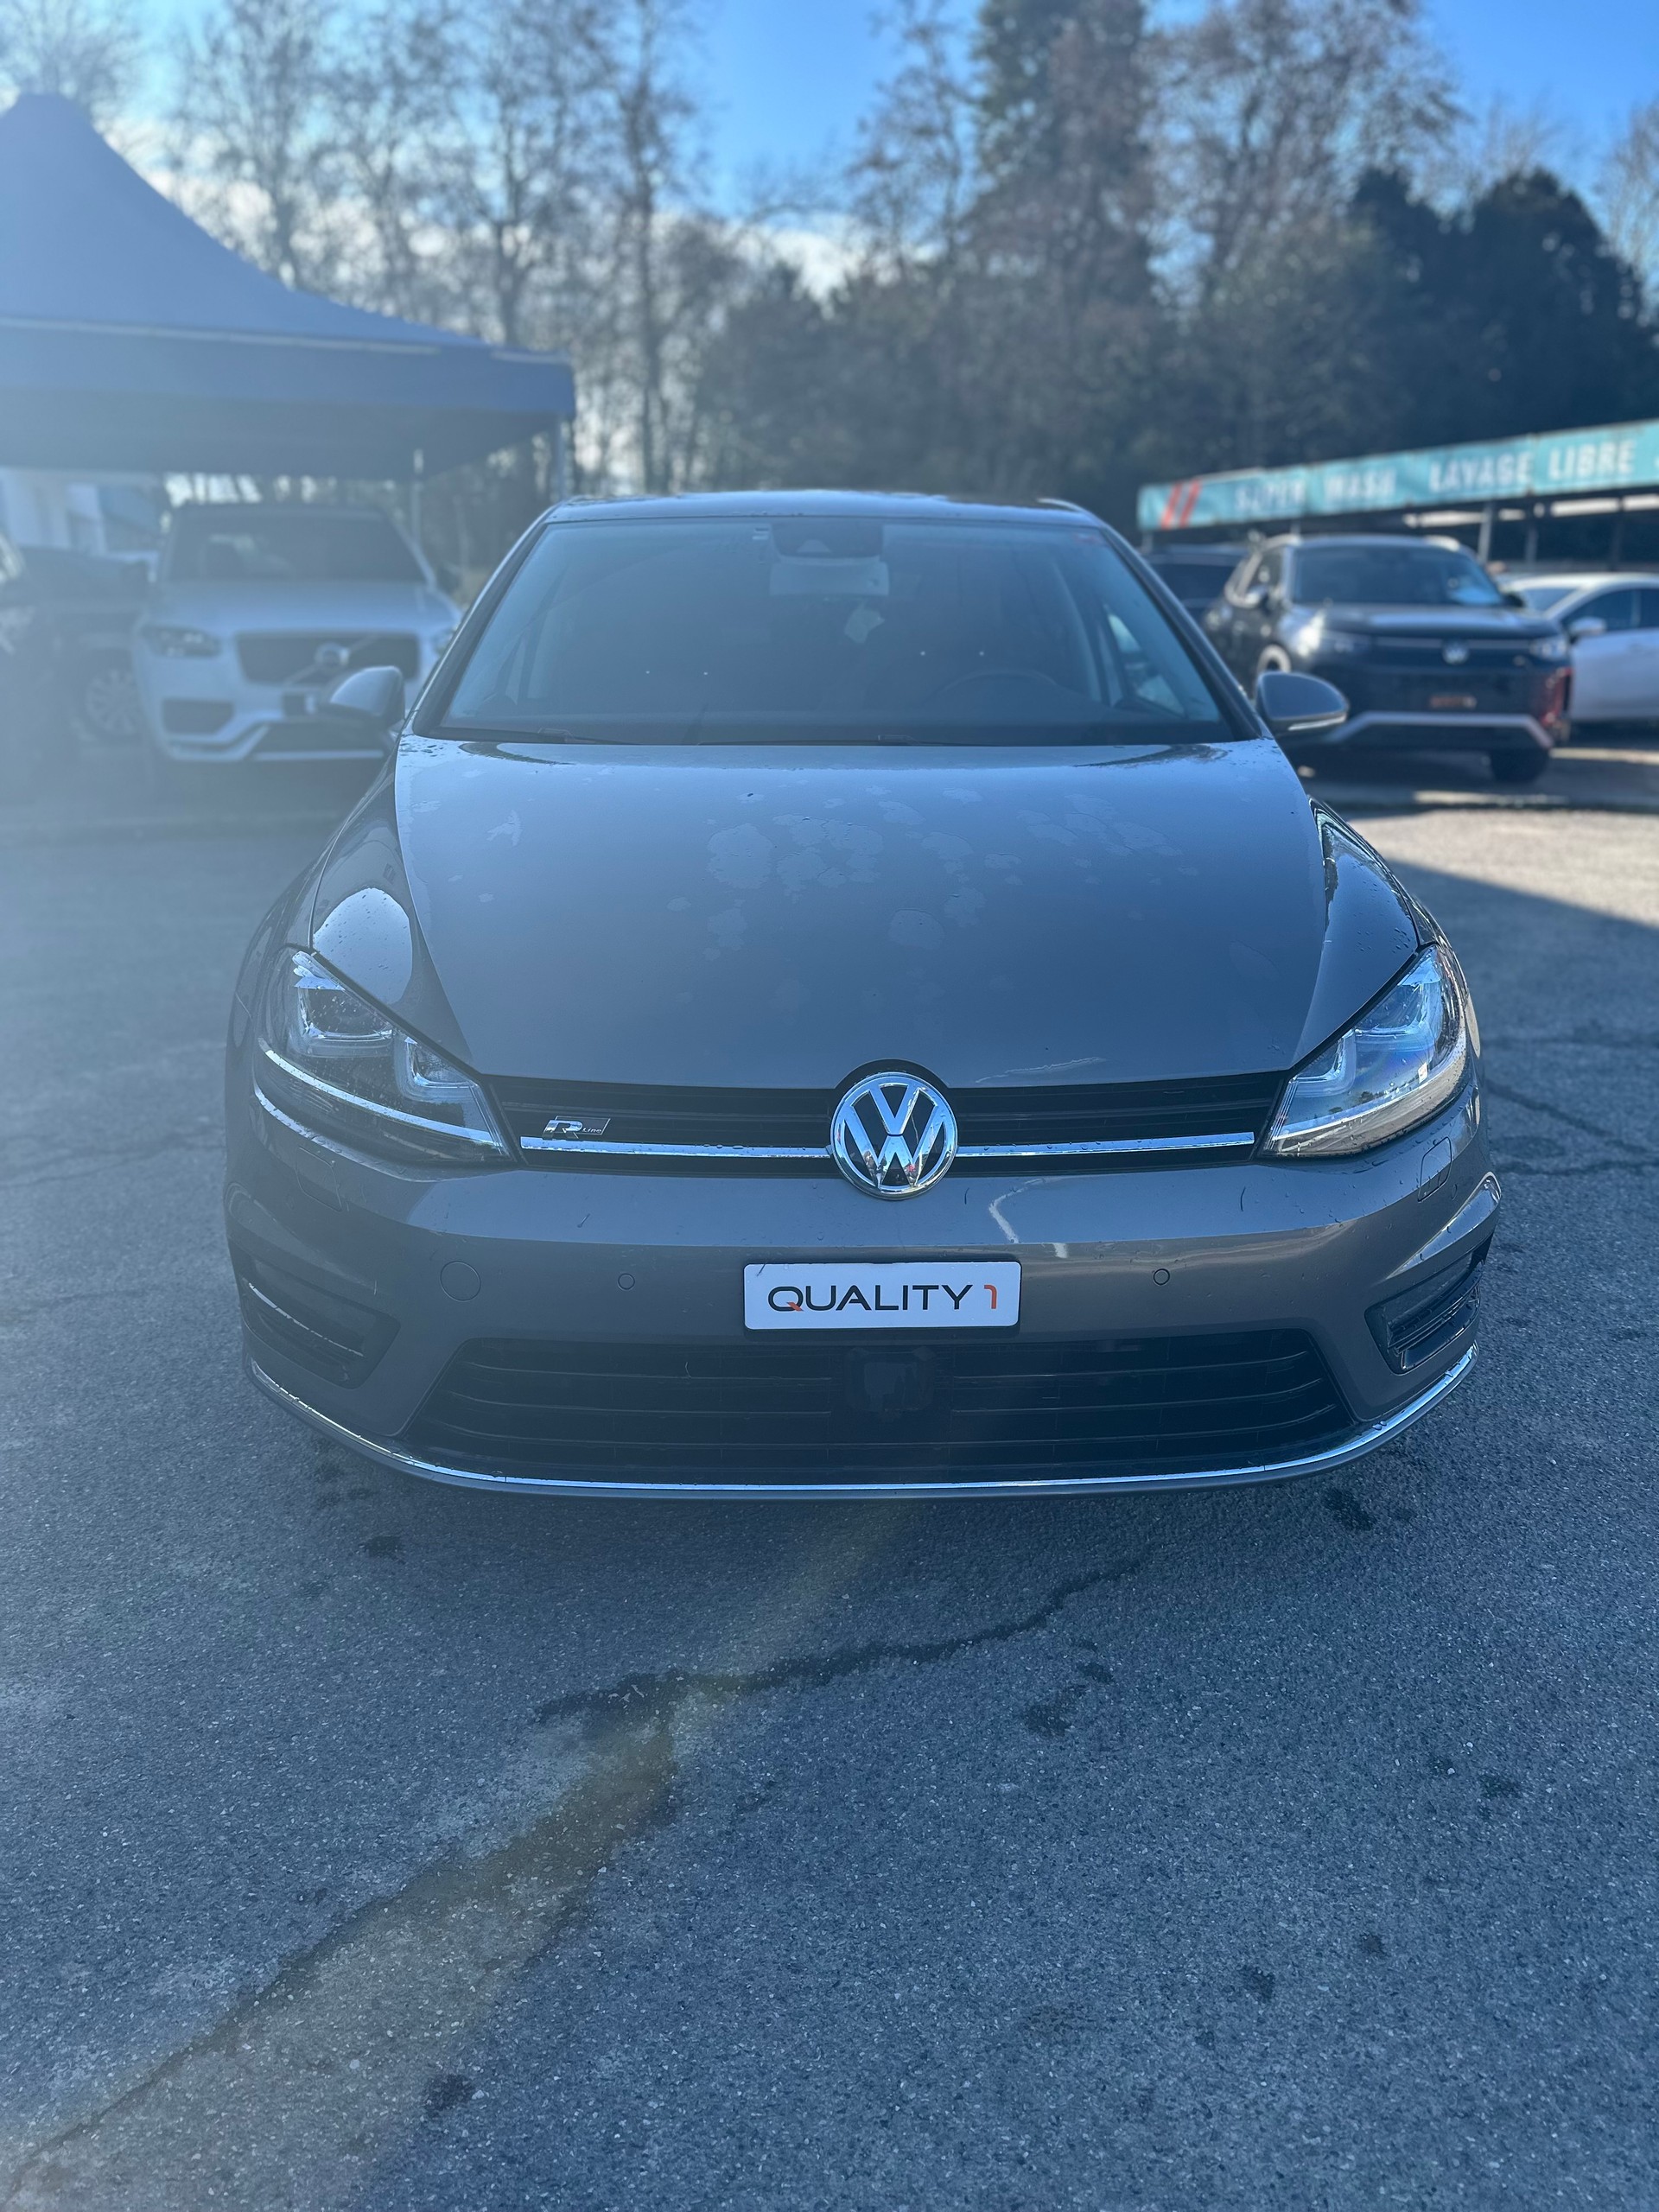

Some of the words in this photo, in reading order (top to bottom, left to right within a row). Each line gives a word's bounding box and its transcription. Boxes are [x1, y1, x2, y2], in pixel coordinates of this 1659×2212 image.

[1429, 450, 1534, 493] LAVAGE
[1548, 439, 1637, 481] LIBRE
[767, 1284, 974, 1312] QUALITY
[983, 1284, 998, 1310] 1
